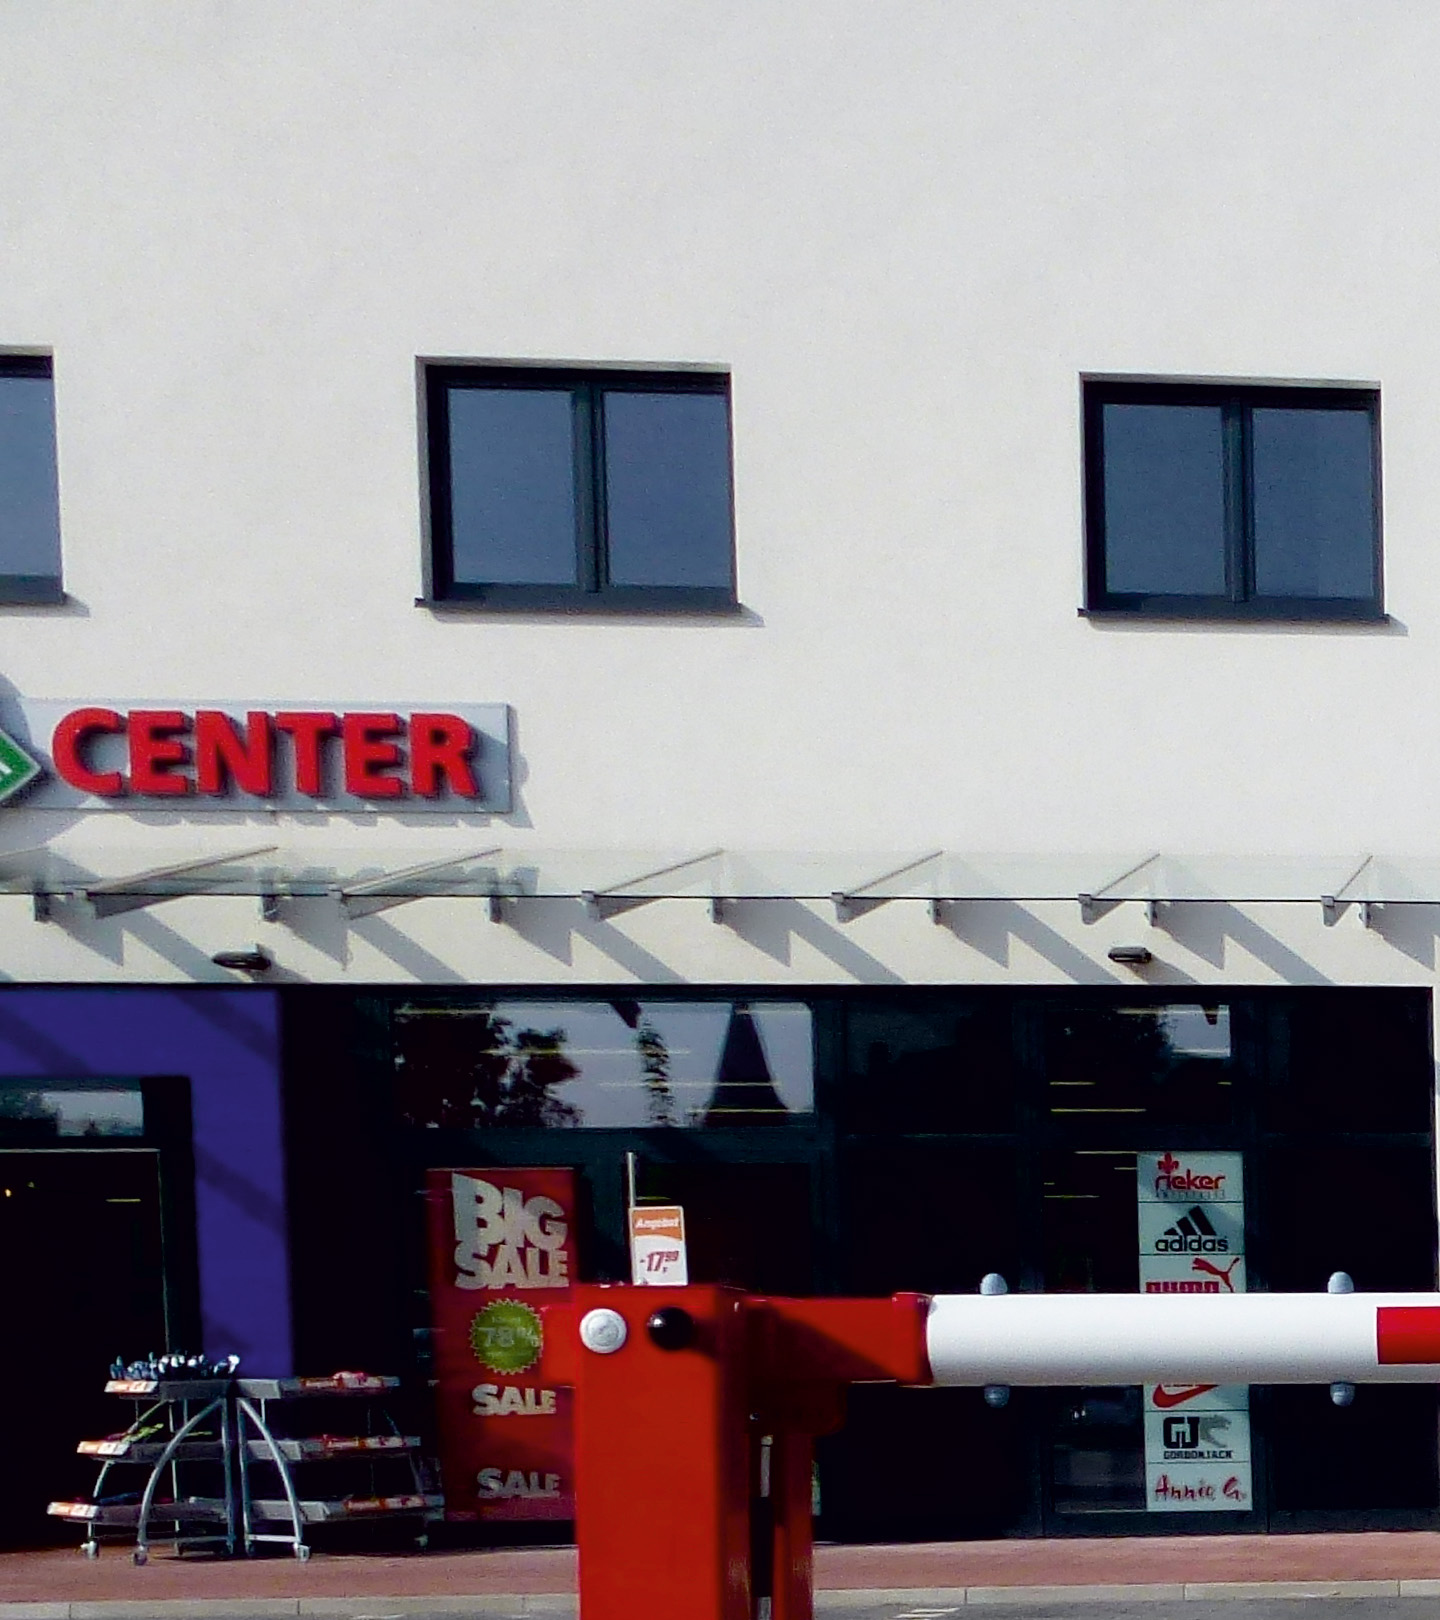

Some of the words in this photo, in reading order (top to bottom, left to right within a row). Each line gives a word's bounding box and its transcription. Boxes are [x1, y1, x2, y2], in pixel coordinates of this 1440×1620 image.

[52, 706, 478, 796] CENTER
[1155, 1168, 1226, 1193] rieker
[451, 1172, 569, 1251] BIG
[1155, 1234, 1229, 1252] adidas
[453, 1241, 570, 1290] SALE
[471, 1383, 557, 1416] SALE
[477, 1467, 562, 1499] SALE
